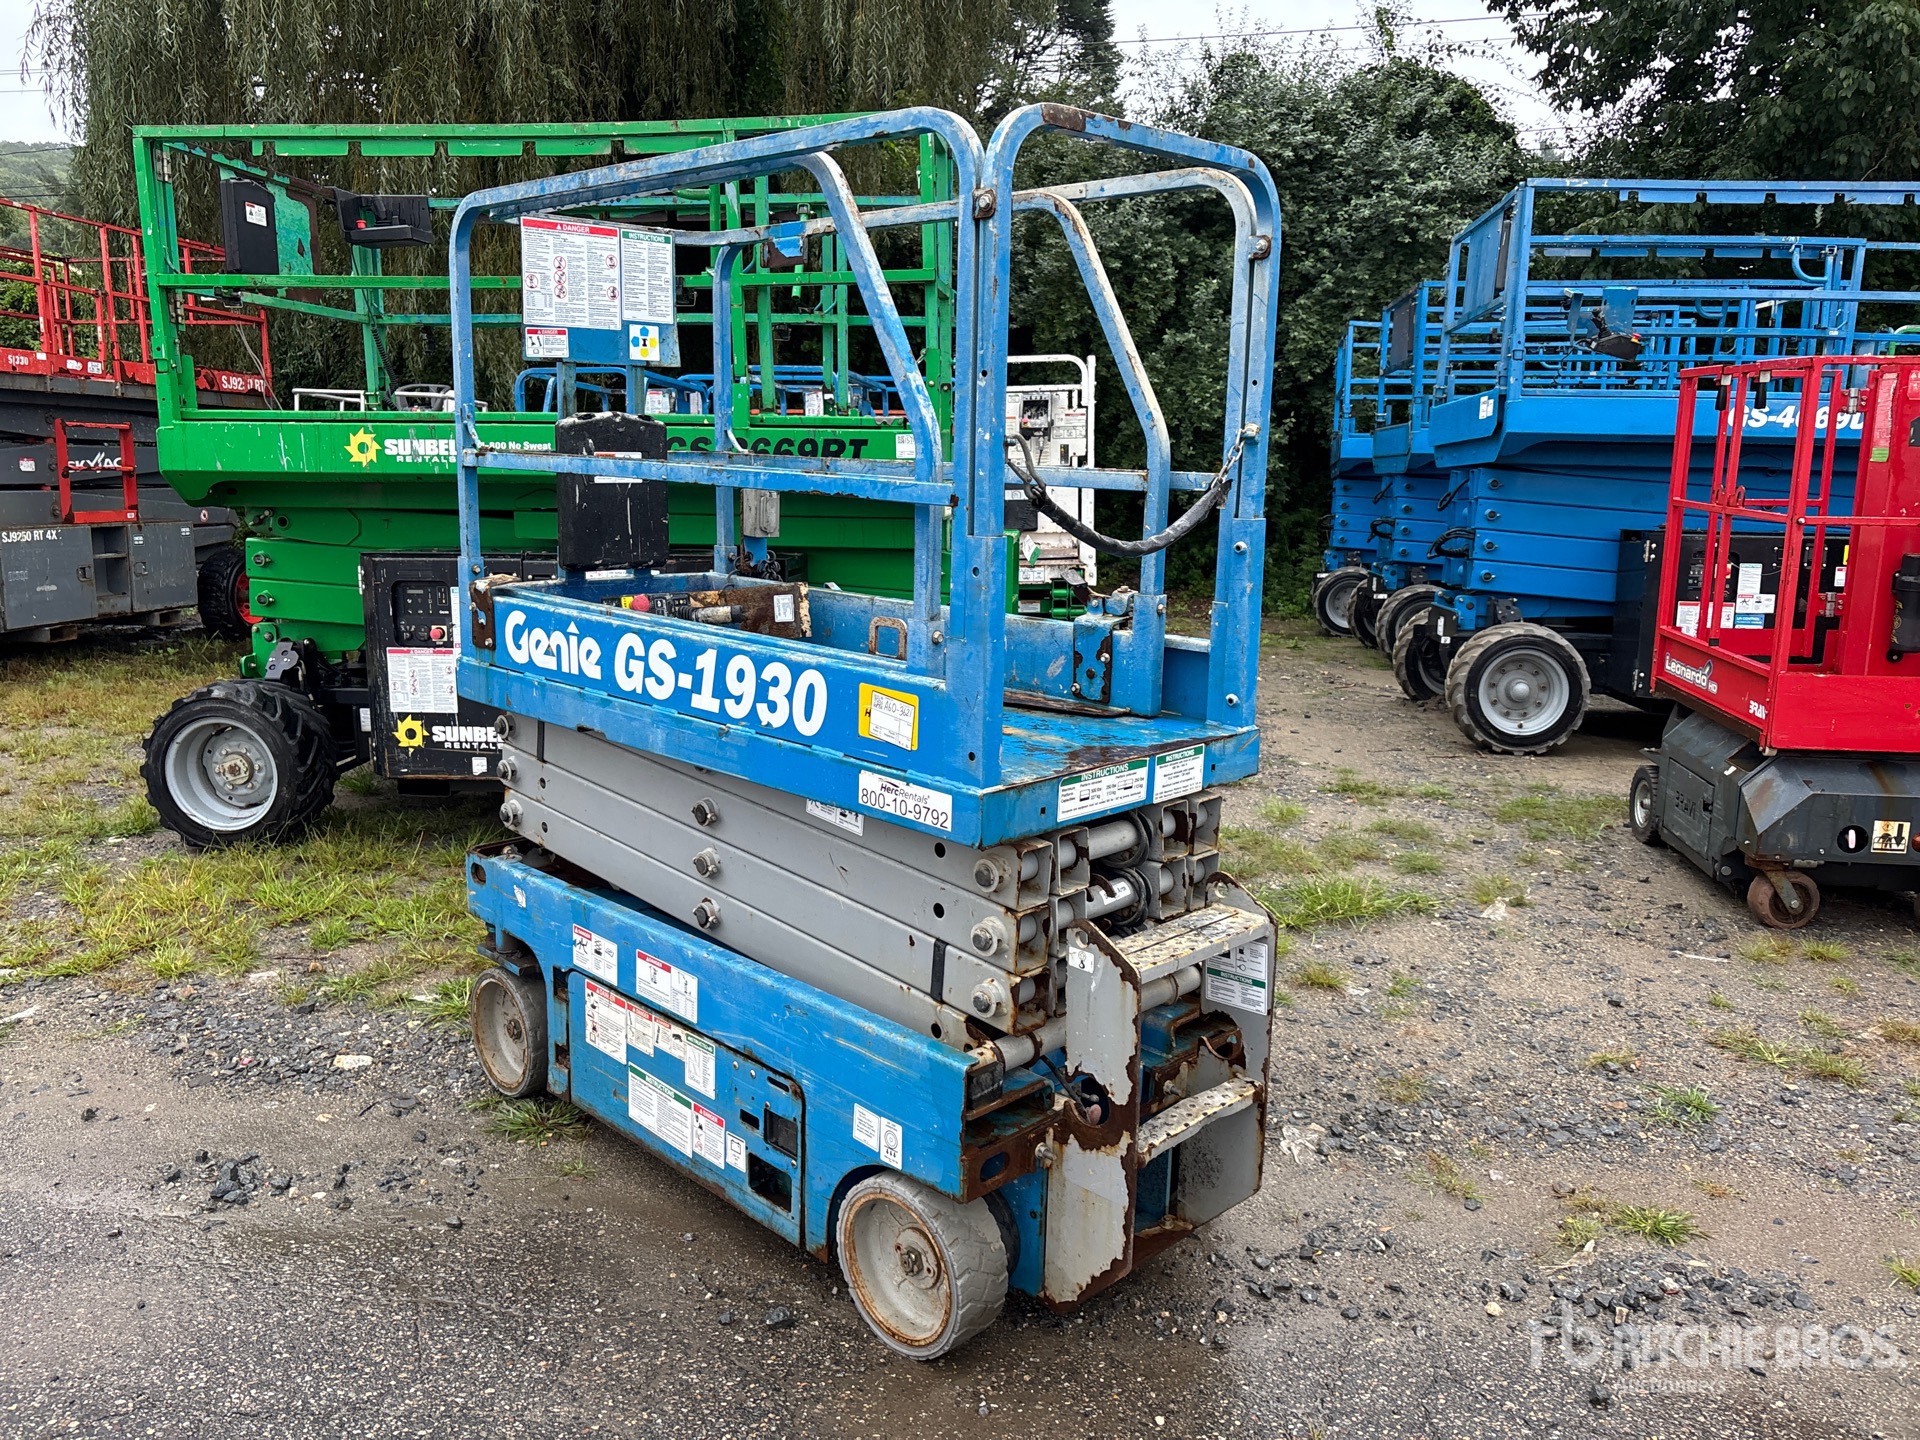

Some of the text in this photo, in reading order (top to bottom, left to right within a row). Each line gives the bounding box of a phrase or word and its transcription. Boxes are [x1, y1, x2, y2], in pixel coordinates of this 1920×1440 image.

[562, 223, 590, 234] DANGER
[628, 232, 666, 243] INSTRUCTIONS
[222, 374, 253, 390] SJ92
[1727, 406, 1864, 429] GS-469
[384, 438, 457, 456] SUNBEL
[508, 441, 522, 450] No
[522, 441, 552, 450] Sweat
[666, 436, 868, 460] GS669RT
[68, 452, 123, 473] SKYJAC
[34, 530, 44, 541] RT
[46, 529, 62, 540] 4X
[504, 610, 828, 737] Genie GS-1930
[1664, 654, 1708, 688] Leonardo
[1748, 700, 1768, 720] BRAV
[432, 725, 504, 743] SUNBE
[1166, 749, 1194, 762] INSTRUCTIONS
[1081, 763, 1128, 782] INSTRUCTIONS
[880, 783, 930, 804] HercRentals
[861, 788, 949, 830] 800-10-9792
[1220, 971, 1253, 984] INSTRUCTIONS
[688, 1034, 714, 1052] INSTRUCTIONS
[646, 1075, 675, 1098] INSTRUCTIONS
